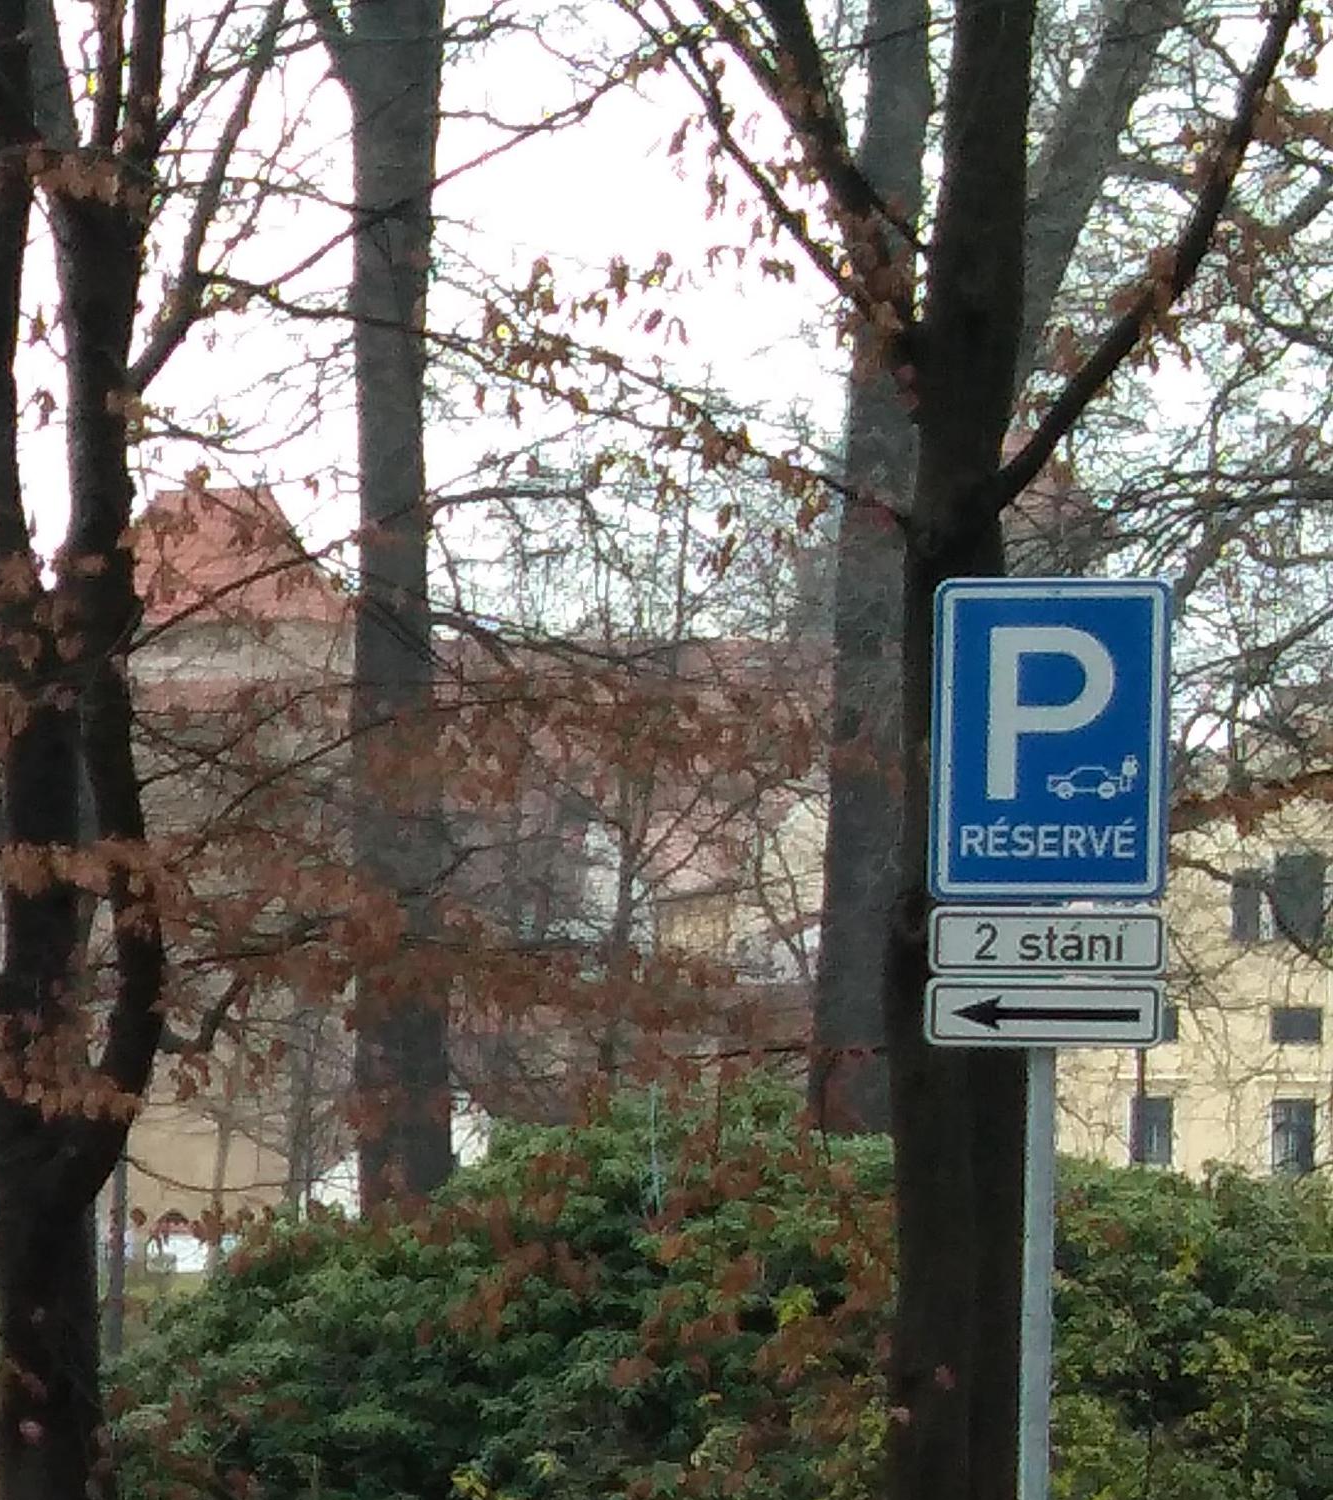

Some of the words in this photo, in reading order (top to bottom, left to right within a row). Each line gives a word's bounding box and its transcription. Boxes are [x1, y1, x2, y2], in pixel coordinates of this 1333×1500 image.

[986, 626, 1116, 800] P
[958, 816, 1137, 860] RÉSERVÉ
[973, 922, 999, 962] 2
[1018, 920, 1130, 962] stání
